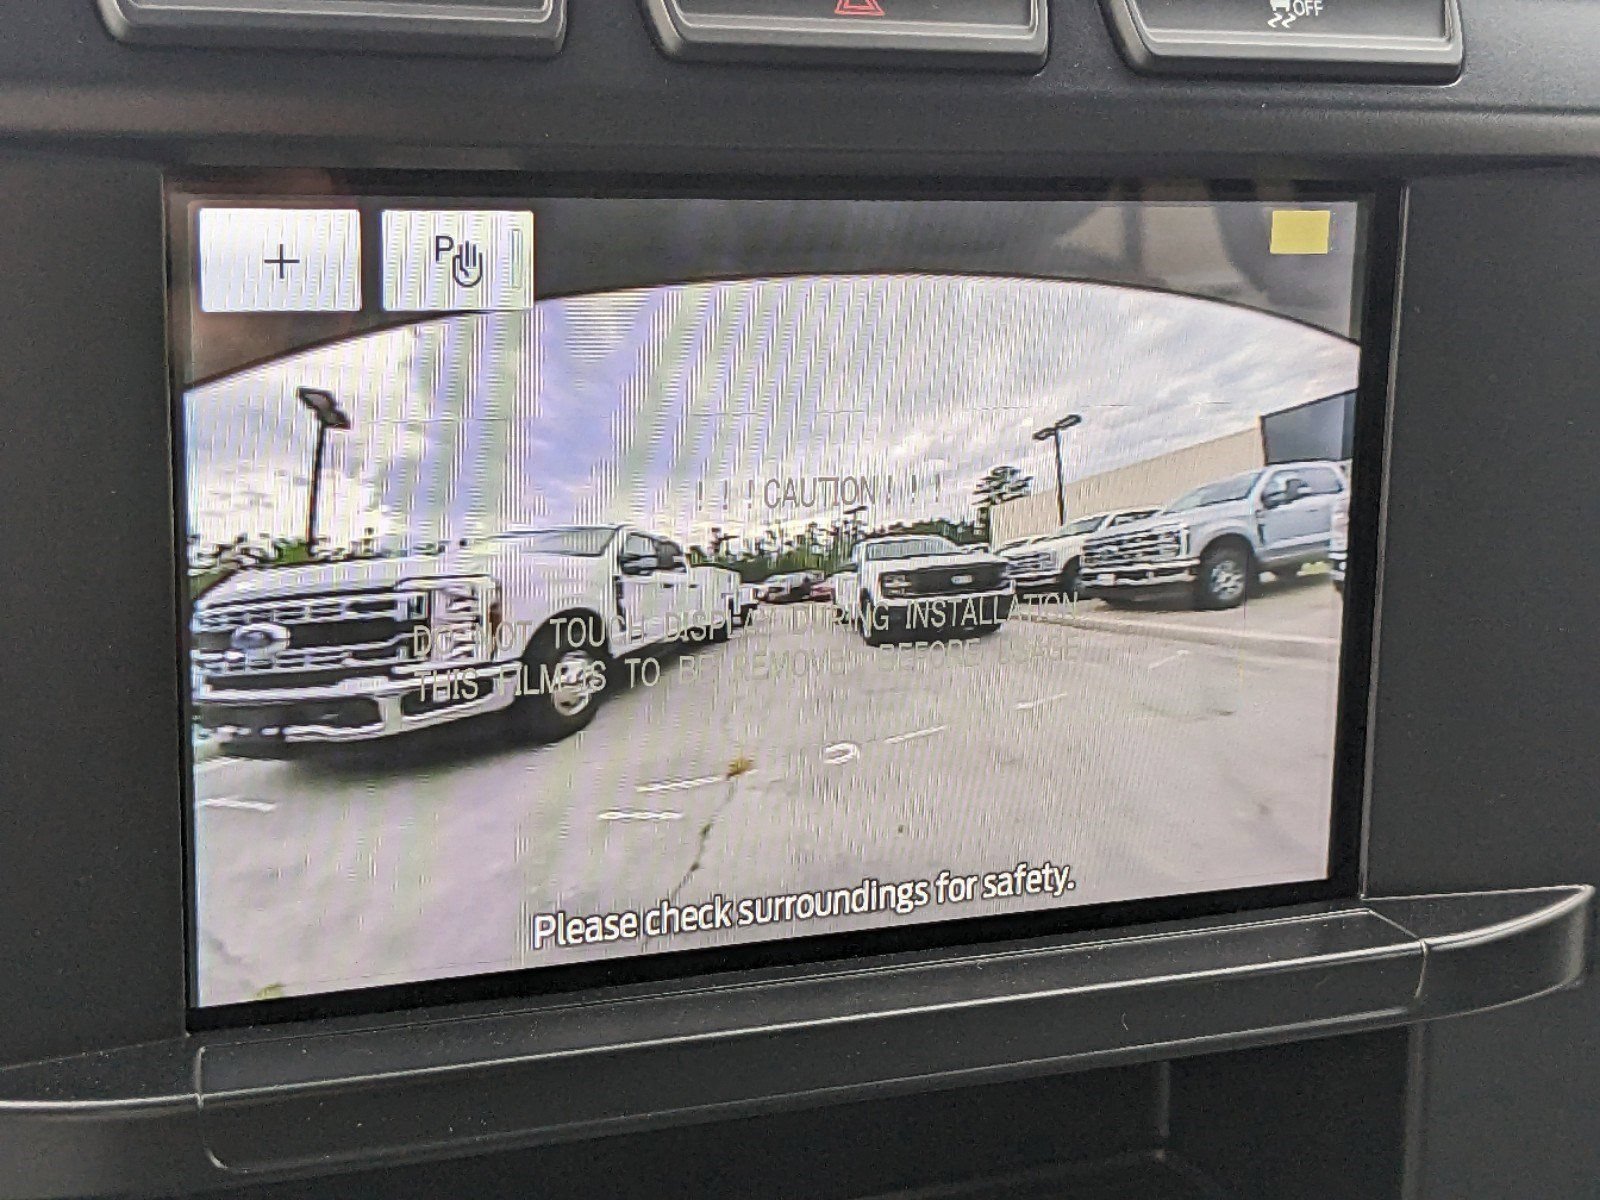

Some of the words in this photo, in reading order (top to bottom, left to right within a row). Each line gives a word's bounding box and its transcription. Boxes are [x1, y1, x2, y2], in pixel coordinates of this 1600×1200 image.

[1292, 0, 1324, 16] OFF
[435, 235, 455, 262] P
[763, 475, 876, 509] CAUTION
[550, 611, 645, 649] TOUCH
[906, 591, 1078, 629] INSTALLATION
[414, 667, 479, 702] THIS
[499, 661, 563, 697] FILM
[625, 656, 661, 689] TO
[679, 655, 718, 685] BE
[733, 646, 866, 683] REMOVE
[877, 638, 981, 672] BEFORE
[533, 909, 639, 950] Please
[644, 894, 733, 937] check
[737, 876, 930, 926] surroundings
[935, 870, 979, 905] for
[981, 861, 1077, 898] safety.
